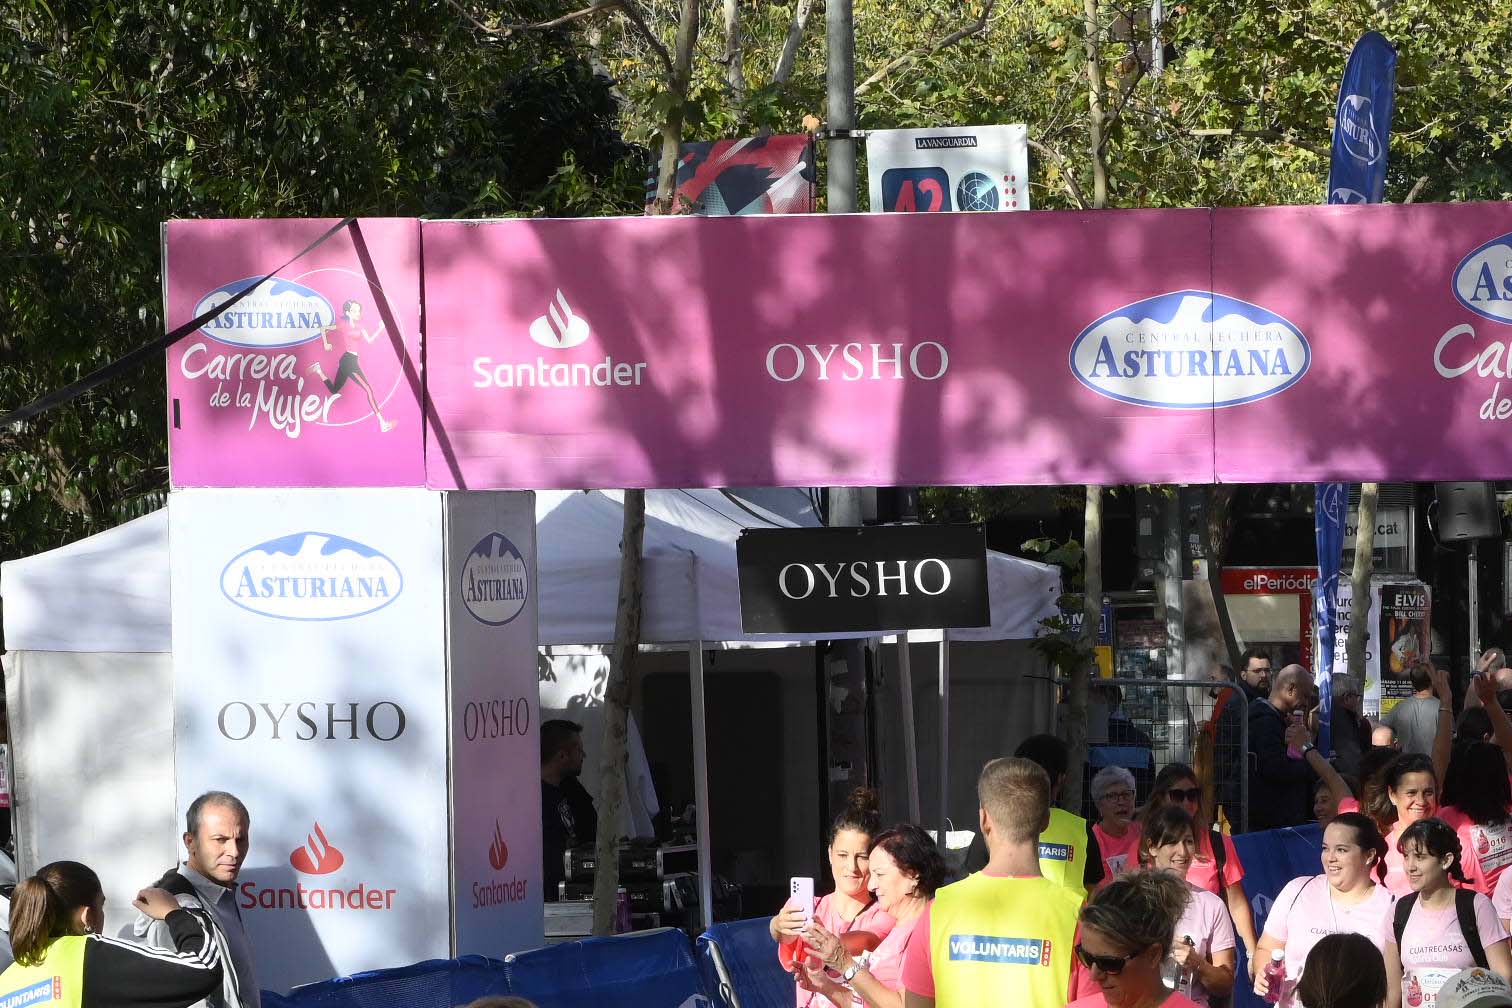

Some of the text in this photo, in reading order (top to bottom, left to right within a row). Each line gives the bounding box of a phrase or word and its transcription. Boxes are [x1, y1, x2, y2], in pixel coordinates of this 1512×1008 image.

[204, 302, 323, 329] ASTURIANA
[1125, 331, 1200, 344] CENTRAL
[181, 342, 297, 380] Carrera
[473, 356, 646, 388] Santander
[766, 341, 950, 382] OYSHO
[1089, 335, 1293, 378] ASTURIANA
[209, 378, 342, 439] de la Mujer
[235, 566, 390, 598] ASTURIANA
[466, 566, 525, 602] ASTURIANA
[779, 558, 952, 600] OYSHO
[1394, 593, 1425, 607] ELVIS
[218, 701, 406, 742] OYSHO
[463, 697, 530, 742] OYSHO
[1039, 846, 1067, 857] TARIS
[239, 881, 396, 911] Santander
[472, 877, 528, 912] Santander
[951, 941, 1039, 958] VOLUNTARIS
[1409, 944, 1463, 955] CUATRECASAS
[1424, 993, 1437, 1002] 01
